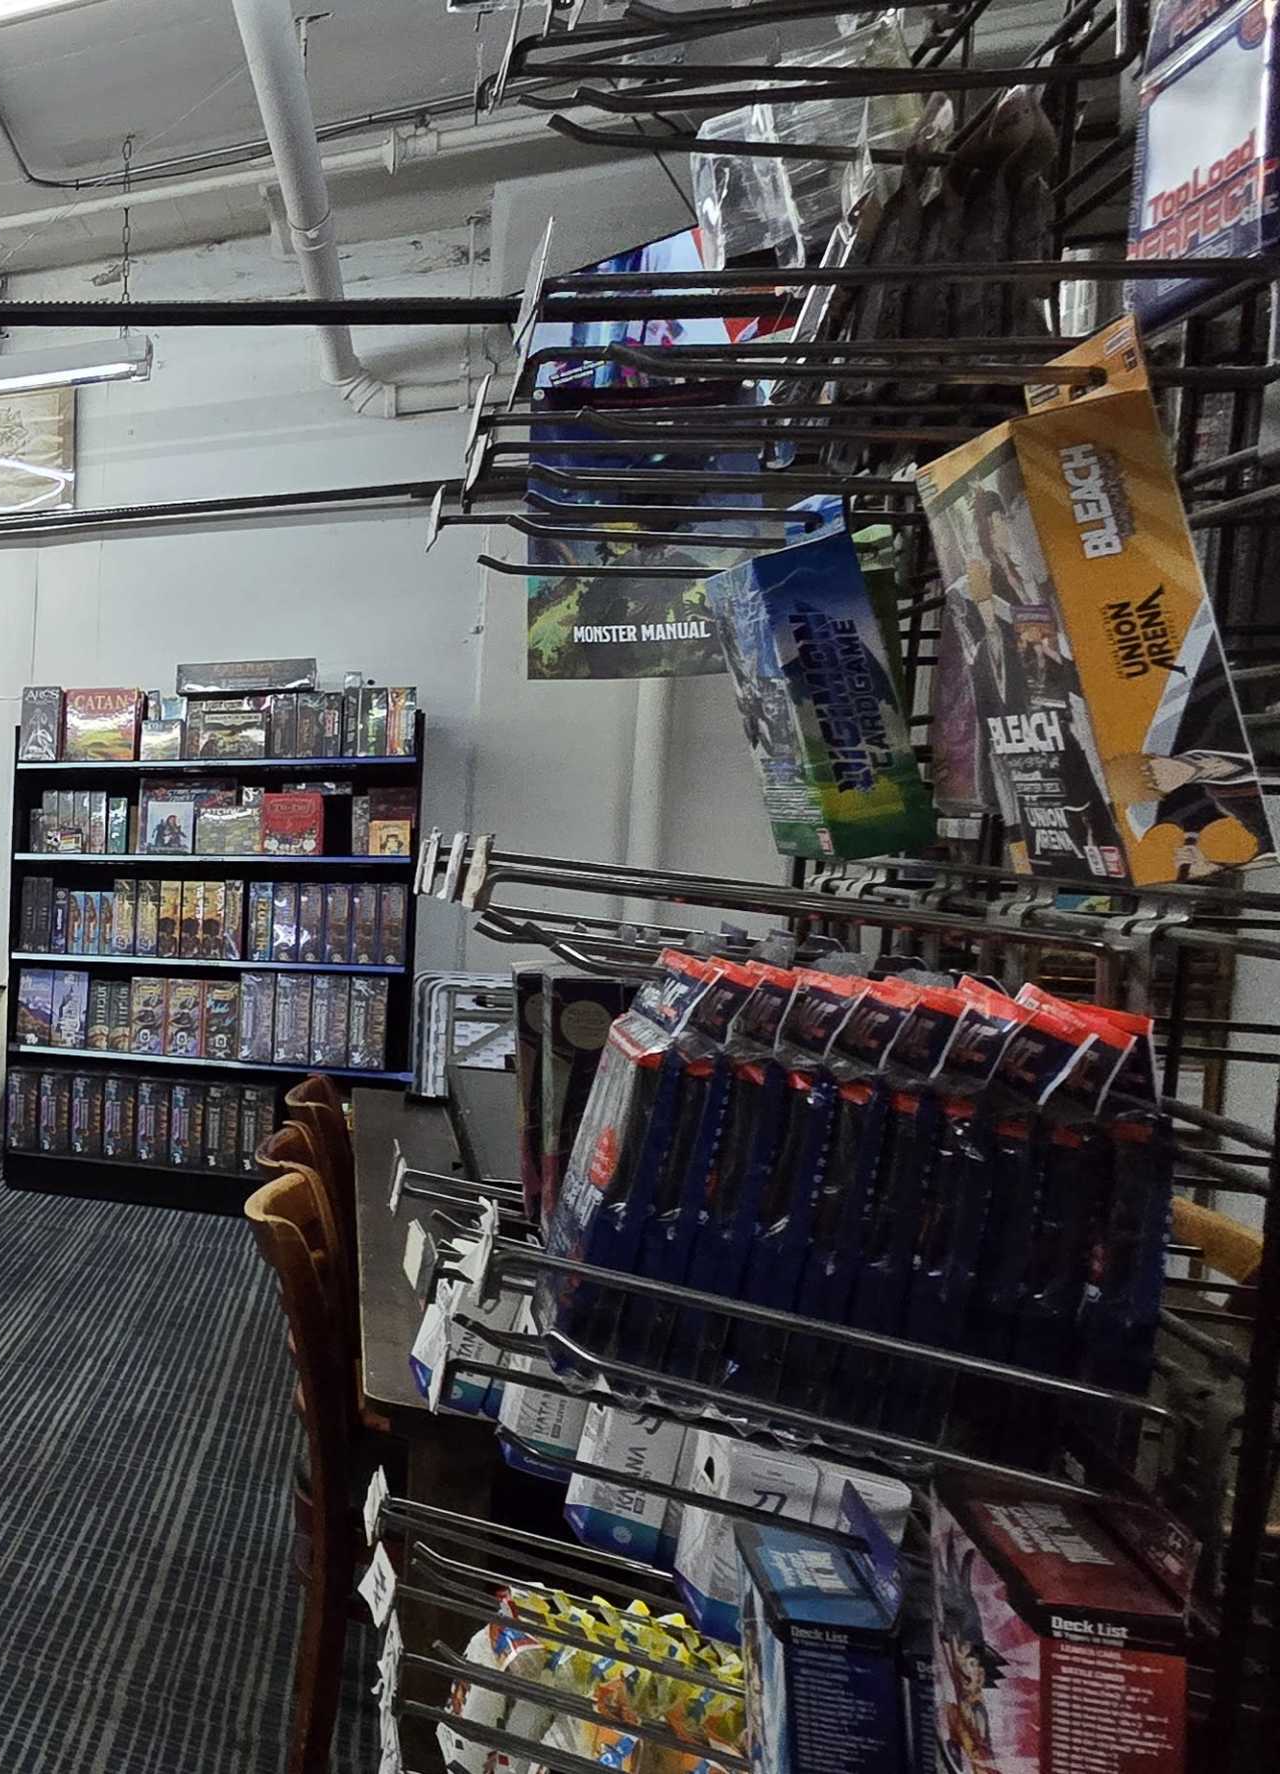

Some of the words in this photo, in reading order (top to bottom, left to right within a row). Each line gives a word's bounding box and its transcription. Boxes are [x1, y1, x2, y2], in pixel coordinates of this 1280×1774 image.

[1059, 443, 1122, 559] BLEACH
[573, 624, 637, 643] MONSTER
[641, 620, 711, 641] MANUAL
[1108, 600, 1149, 679] UNION
[1136, 583, 1188, 677] ARENA
[26, 689, 59, 701] ARCS
[74, 695, 129, 712] CATAN
[788, 611, 874, 793] DIGIMON
[987, 711, 1065, 754] BLEACH
[1024, 807, 1069, 828] UNION
[1051, 1616, 1093, 1633] Deck
[1097, 1623, 1128, 1639] List
